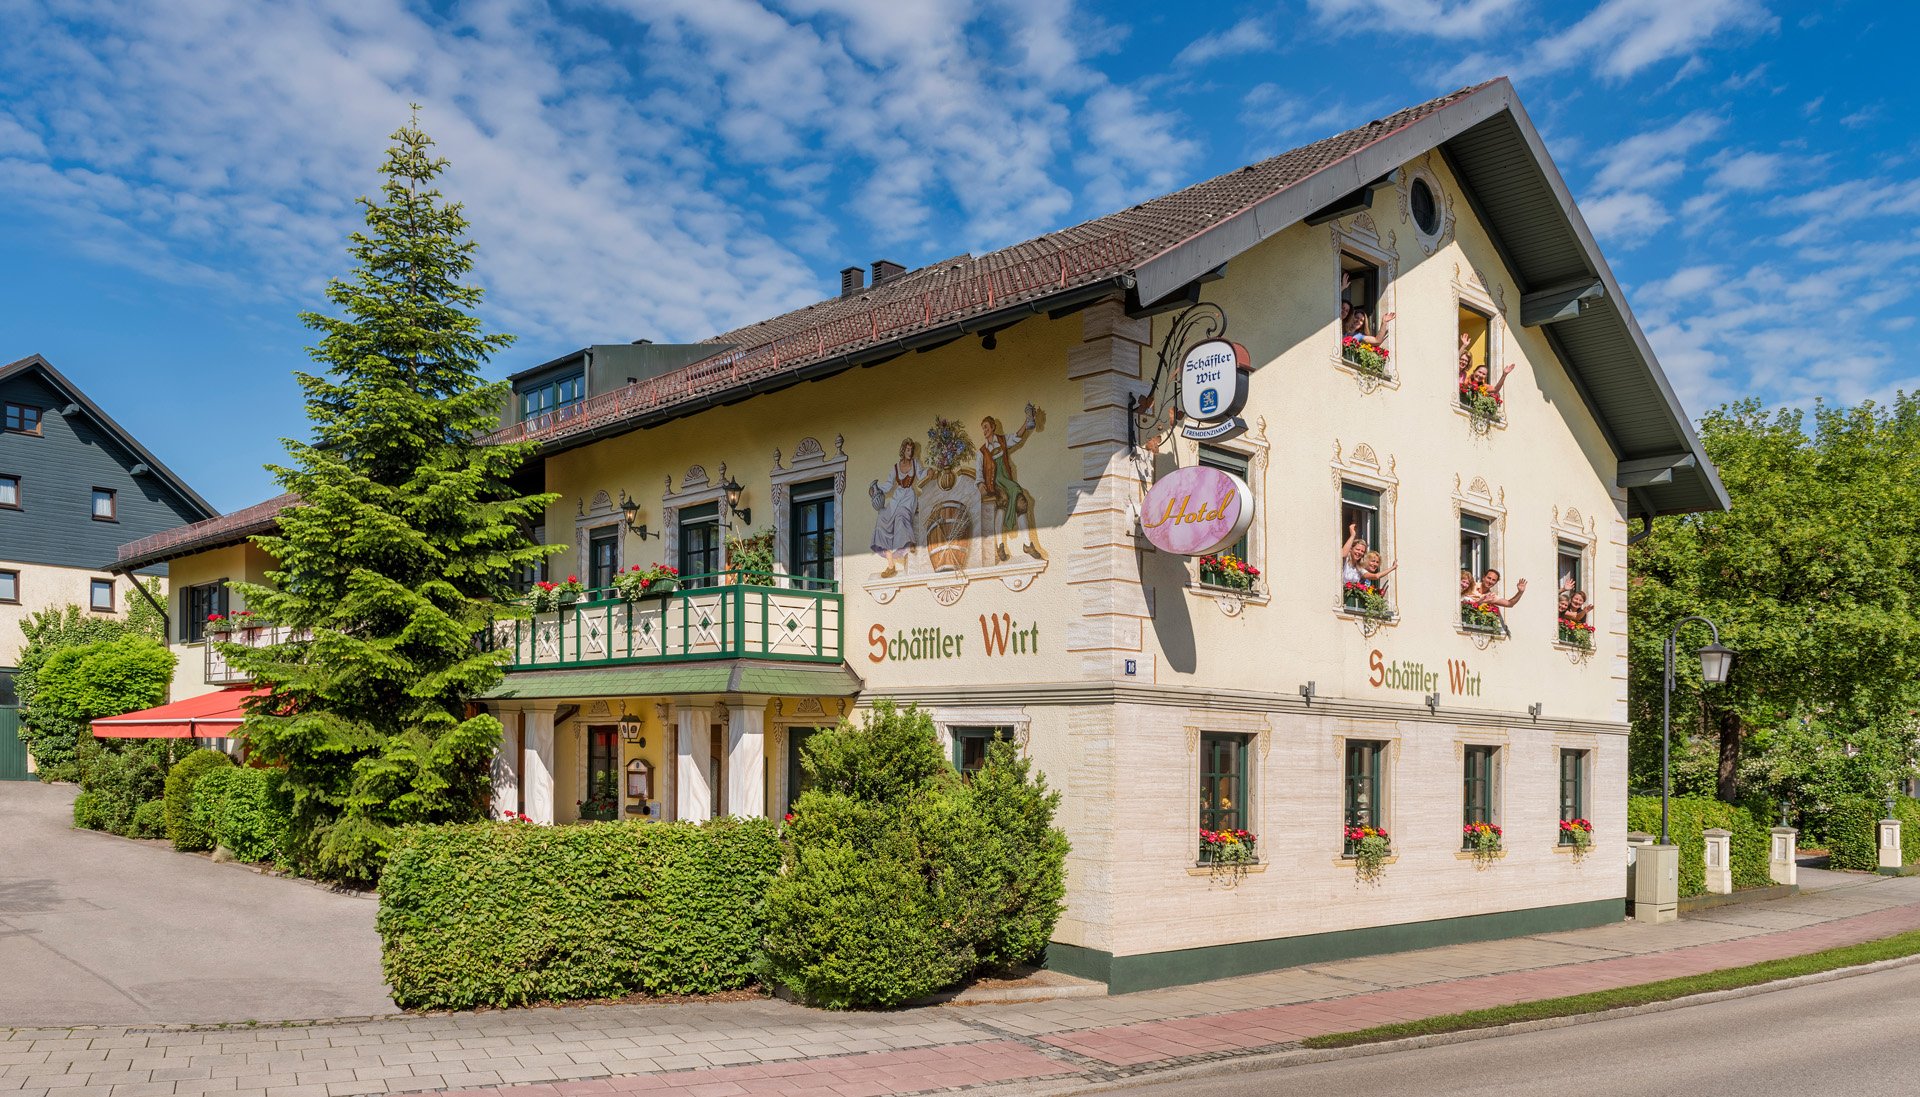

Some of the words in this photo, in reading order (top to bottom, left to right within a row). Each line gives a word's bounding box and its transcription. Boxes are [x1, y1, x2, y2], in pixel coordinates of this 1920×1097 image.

[1186, 353, 1232, 372] Schäffler
[1196, 370, 1221, 385] Wirt
[1185, 422, 1232, 439] FREMDENZIMMER
[1144, 489, 1235, 528] Hotel
[868, 623, 964, 663] Schäffler
[979, 612, 1039, 657] Wirt
[1369, 649, 1438, 693] Schäffler
[1448, 658, 1481, 697] Wirt
